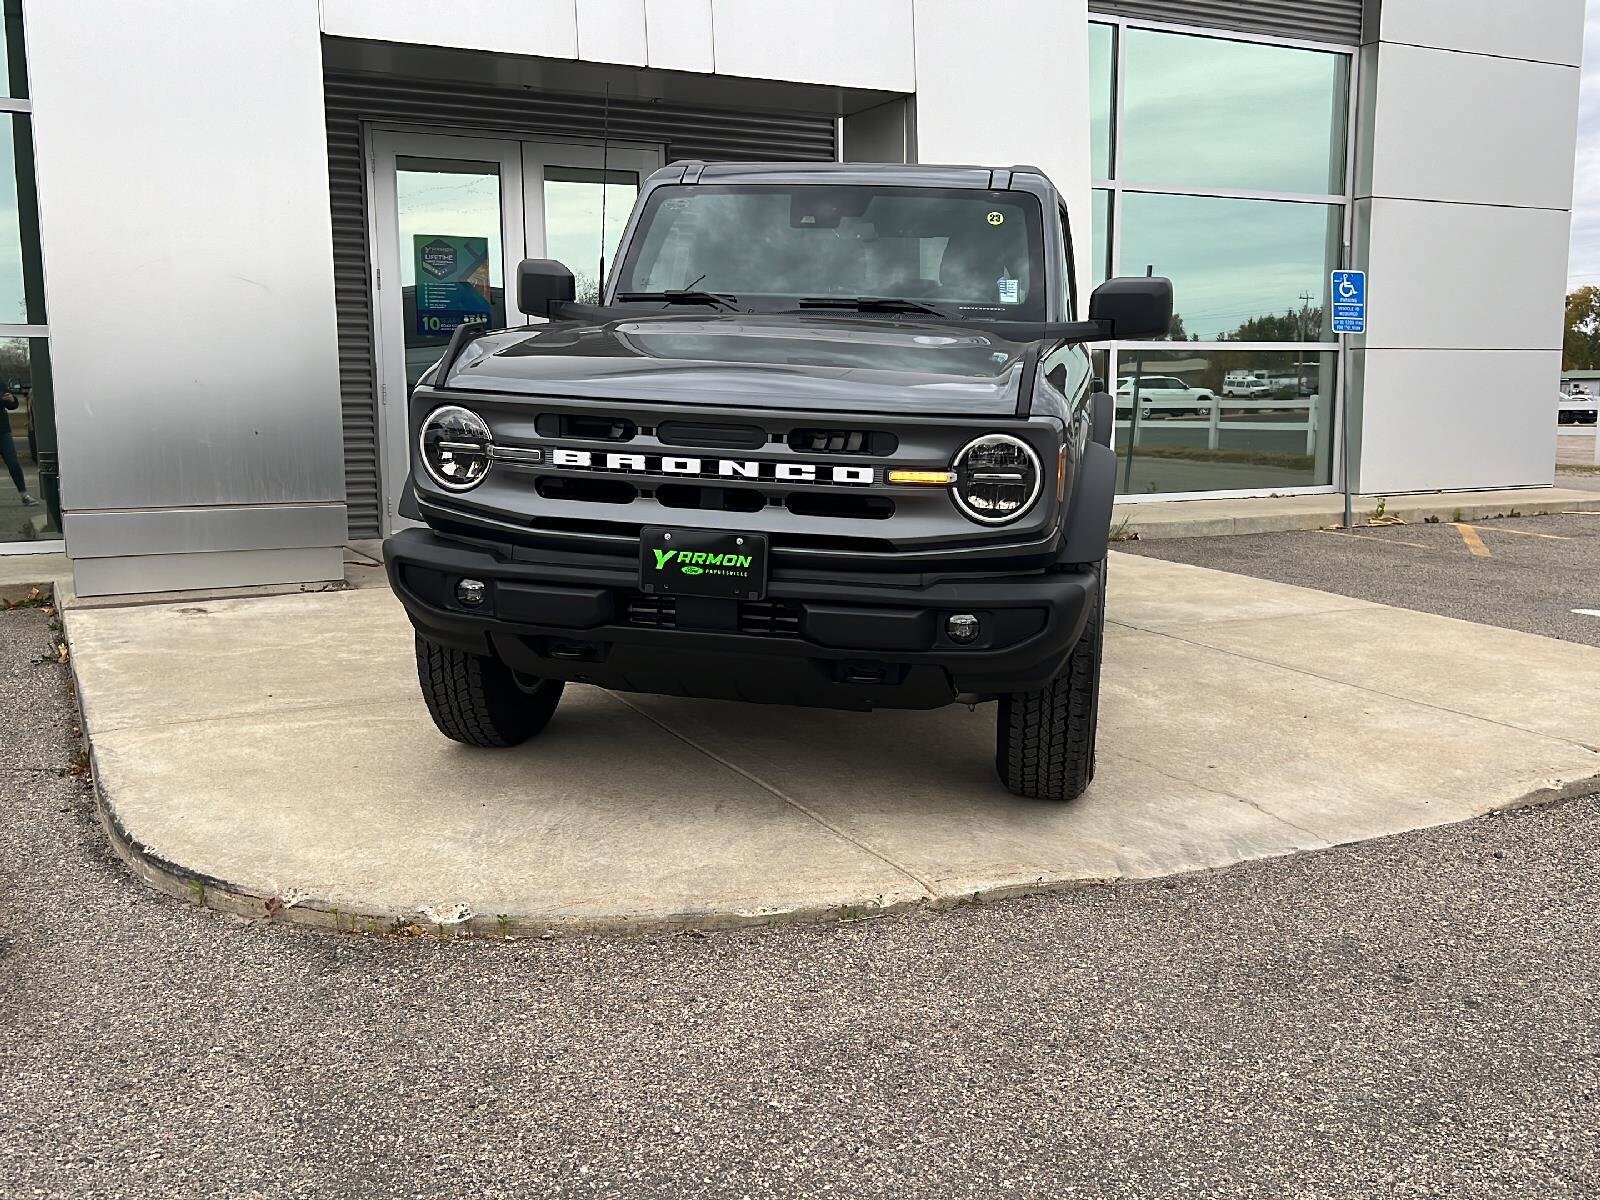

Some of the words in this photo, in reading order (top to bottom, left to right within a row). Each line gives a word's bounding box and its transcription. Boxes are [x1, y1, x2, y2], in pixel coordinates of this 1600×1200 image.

[989, 213, 1001, 222] 23
[422, 316, 440, 330] 10
[553, 449, 874, 484] BRONCO
[653, 548, 752, 570] YARMON
